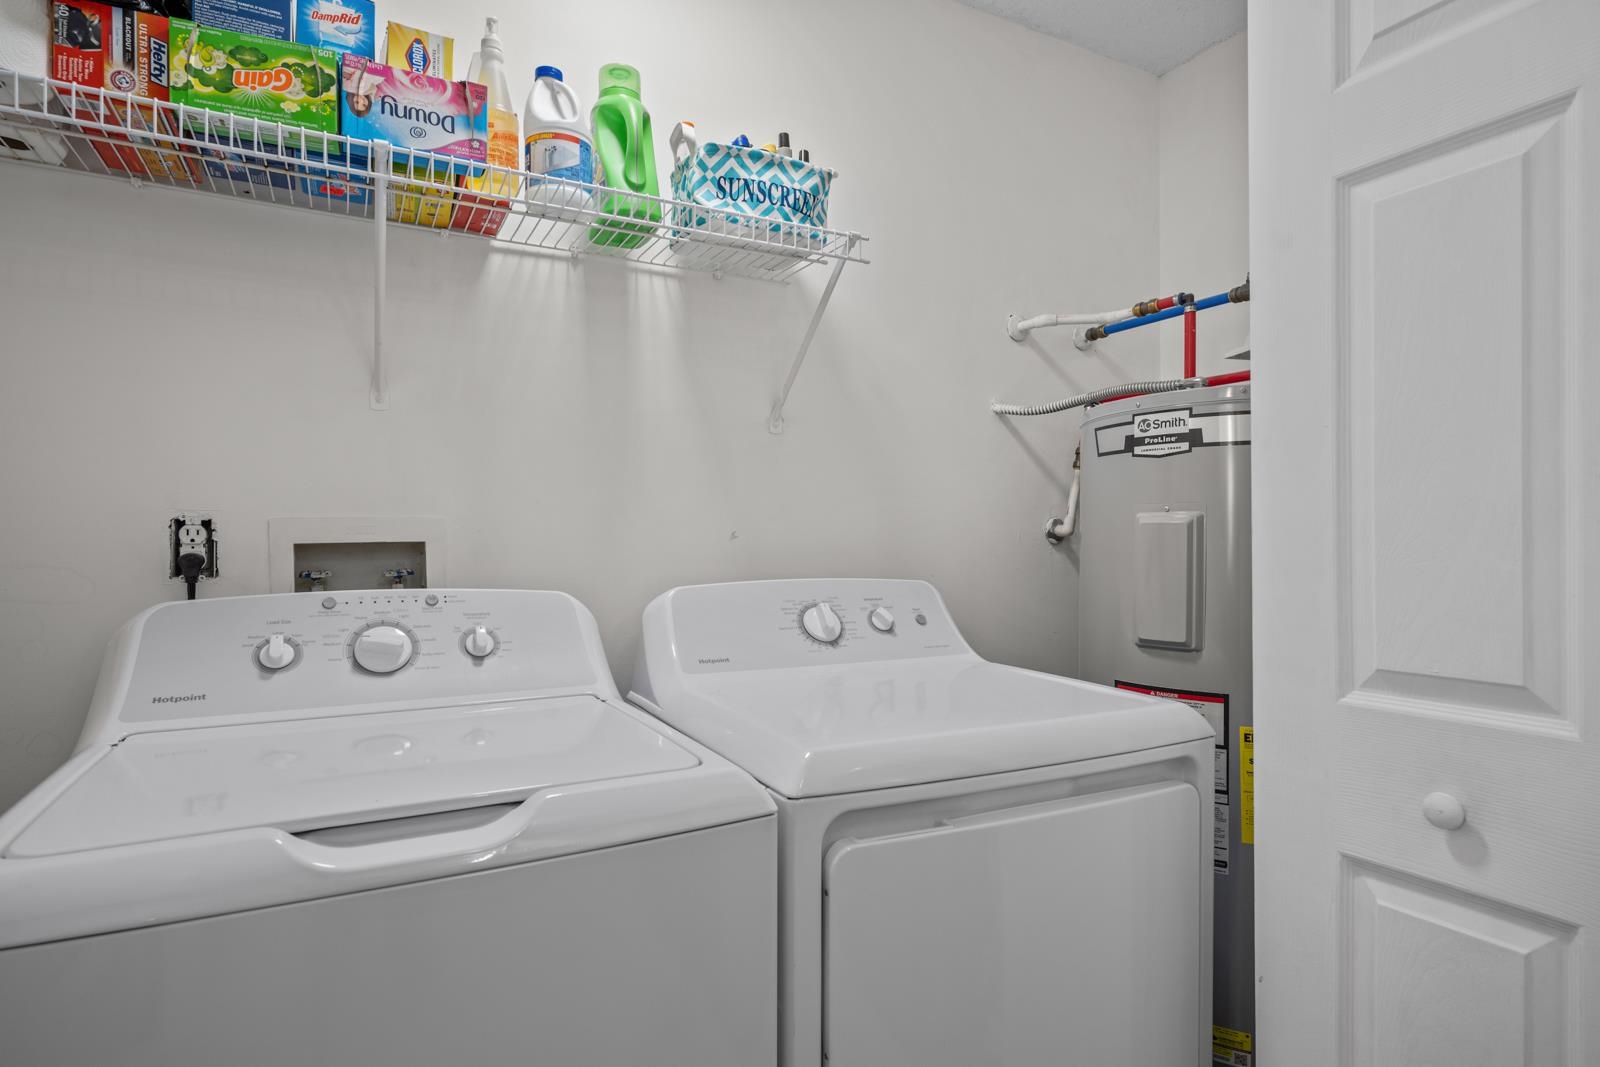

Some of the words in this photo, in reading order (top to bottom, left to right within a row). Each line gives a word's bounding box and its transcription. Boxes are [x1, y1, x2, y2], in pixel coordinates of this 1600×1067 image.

[58, 4, 69, 16] 40
[311, 10, 361, 25] DampRid
[139, 23, 148, 54] ULTRA
[151, 40, 166, 83] Hefty
[412, 41, 424, 74] CLOROX
[139, 56, 148, 96] STRONG
[233, 67, 294, 92] Gain
[381, 95, 455, 134] Downy
[1152, 417, 1186, 430] Smith
[1144, 436, 1177, 444] ProLine
[698, 656, 730, 665] Hotpoint
[151, 693, 207, 705] Hotpoint
[1156, 691, 1179, 699] DANGER
